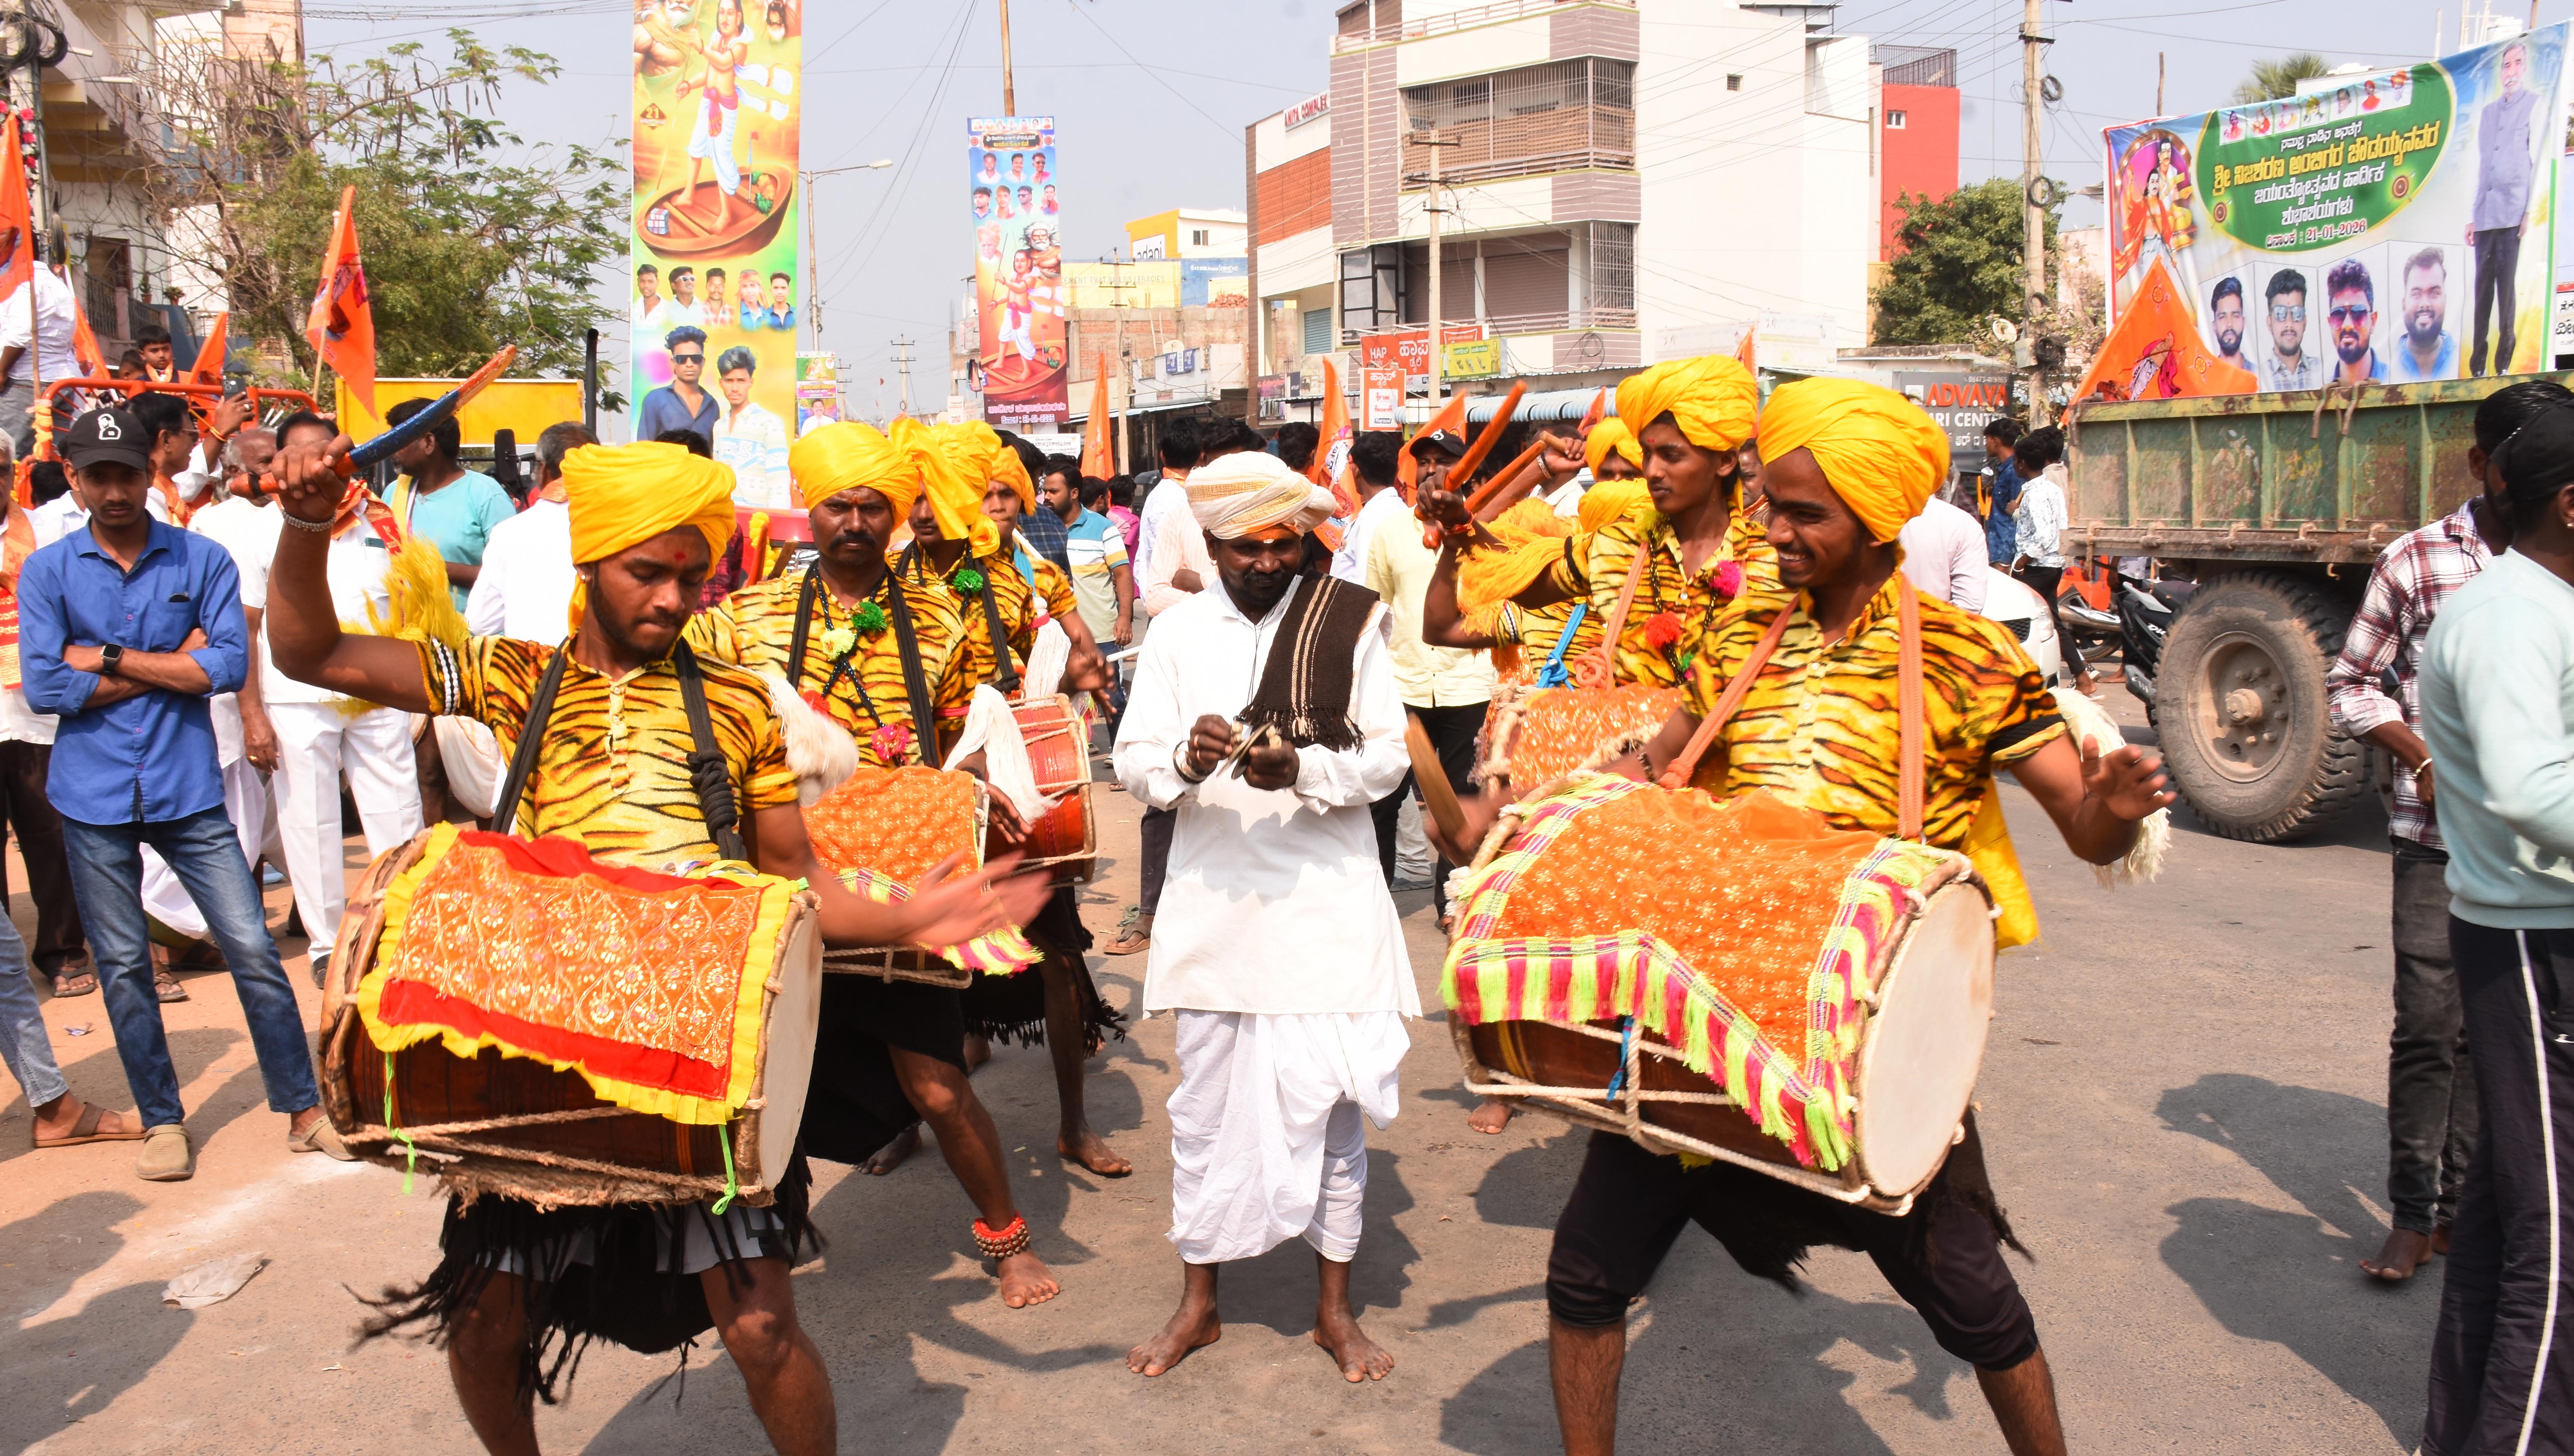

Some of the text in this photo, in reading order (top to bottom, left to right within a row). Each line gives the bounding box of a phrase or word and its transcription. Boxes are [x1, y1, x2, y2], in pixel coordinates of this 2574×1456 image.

[646, 107, 659, 118] 21
[1285, 93, 1328, 127] ANITA COMPLEX
[2281, 121, 2362, 152] ಸಮಸ್ತ ನಾಡಿನ ಜನತೆಗೆ
[2213, 120, 2440, 196] ಶ್ರೀ ನಿಜಶರಣ ಅಂಬಿಗರ ಚೌಡಯ್ಯನವರ
[2255, 161, 2385, 205] ಜಯಂತ್ಯೋತ್ಸವದ ಹಾರ್ದಿಕ
[2282, 195, 2354, 226] ಶುಭಾಶಯಗಳು
[2267, 230, 2296, 247] ದಿನಾಂಕ
[2306, 219, 2366, 241] 21-01-2026
[1370, 347, 1387, 359] HAP
[1925, 383, 2009, 408] ADVAYA
